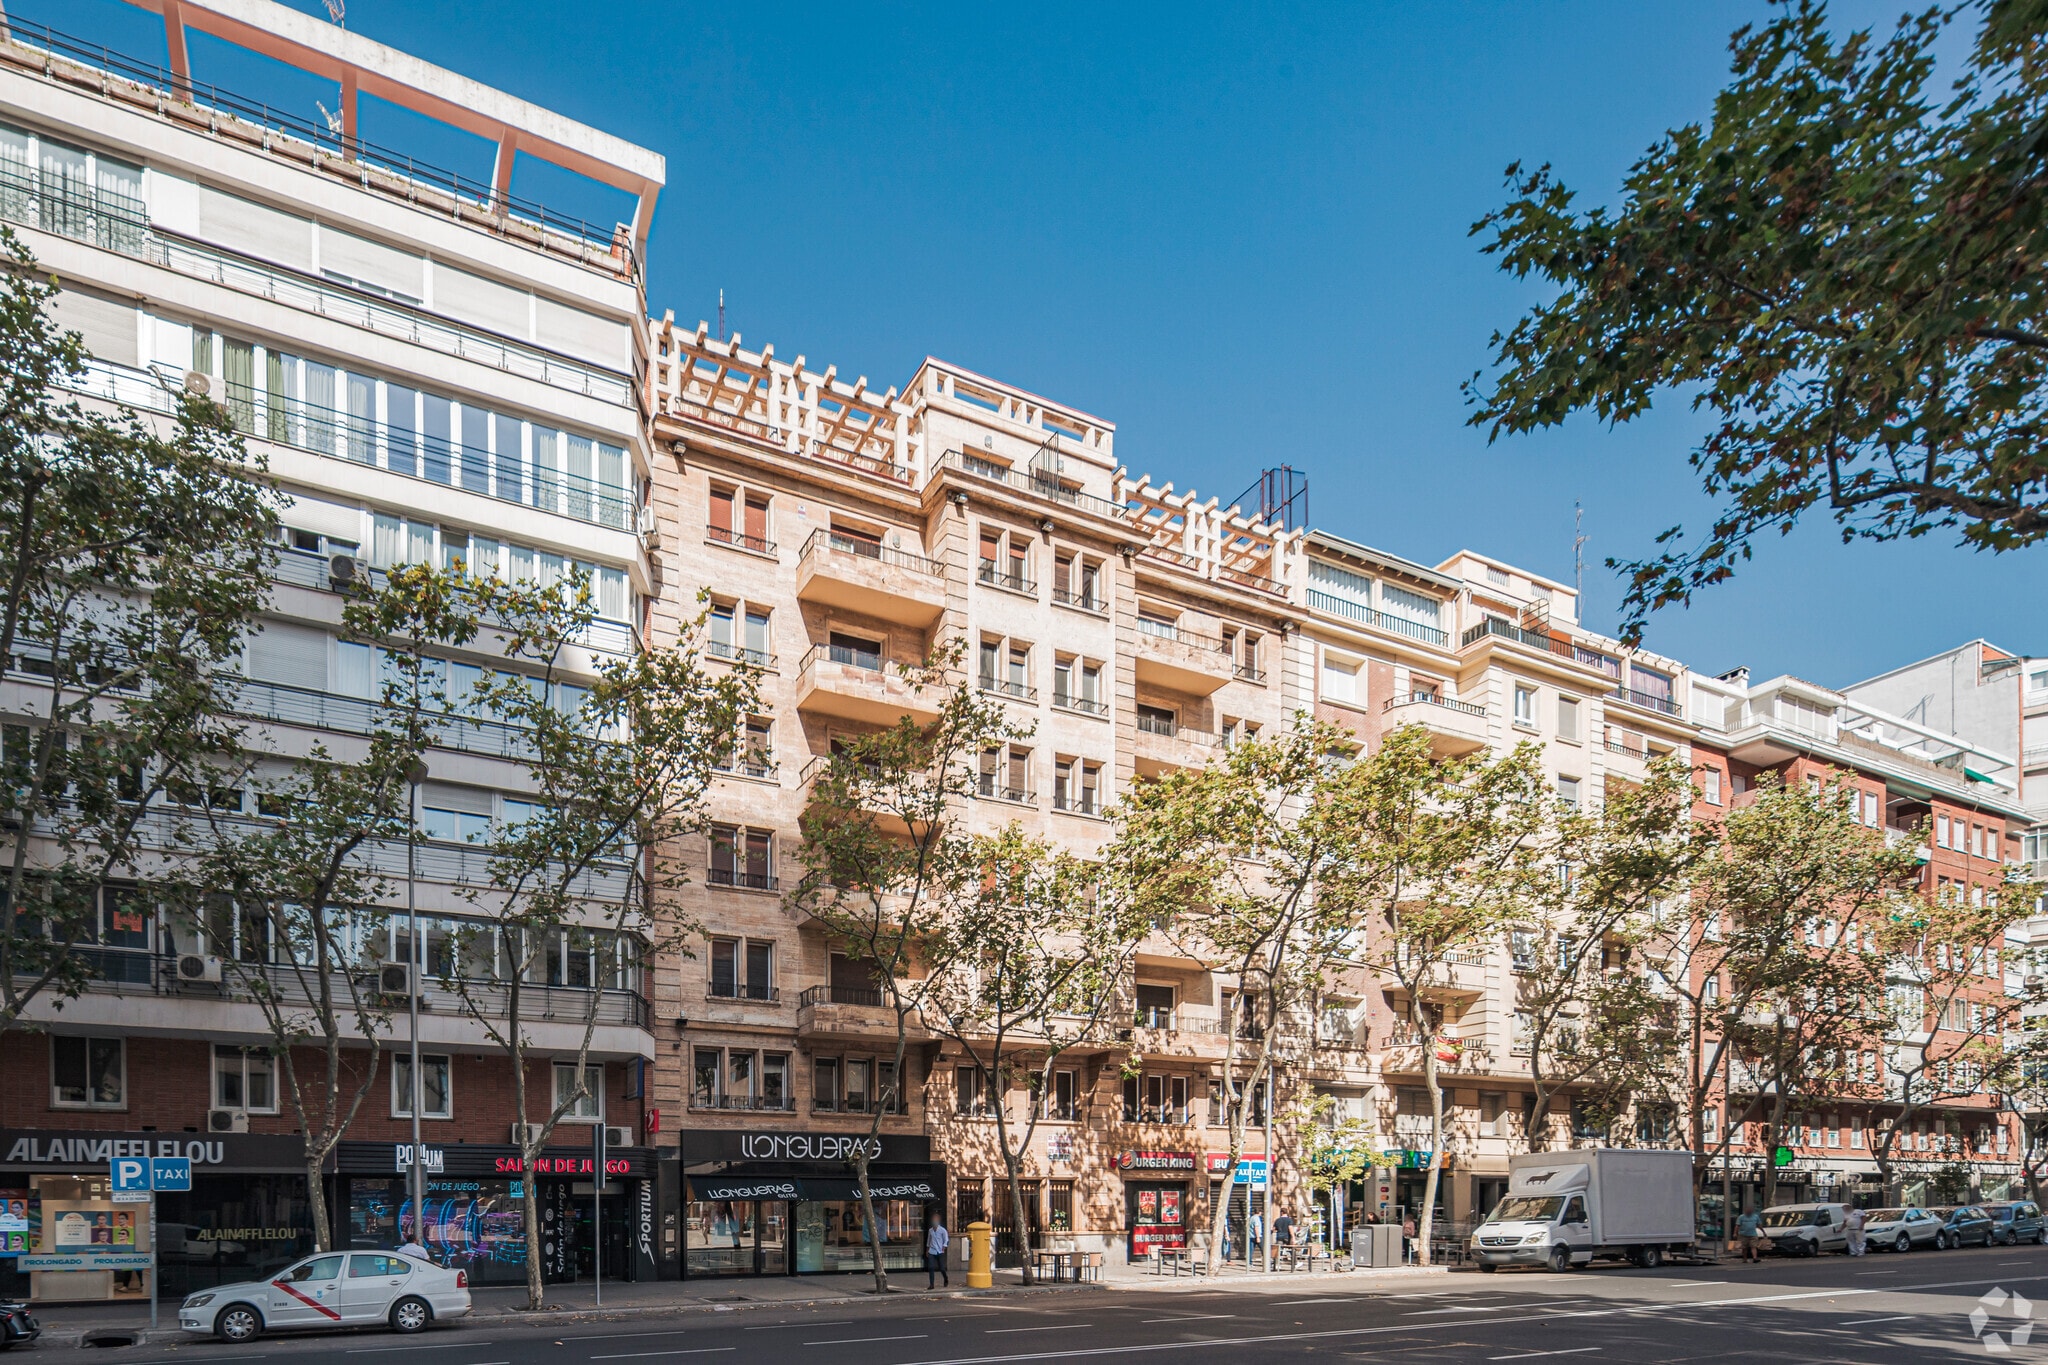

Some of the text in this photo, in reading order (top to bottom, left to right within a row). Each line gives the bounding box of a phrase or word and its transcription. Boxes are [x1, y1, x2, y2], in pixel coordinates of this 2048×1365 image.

[396, 1144, 443, 1166] POIUM
[555, 1158, 577, 1173] DE
[580, 1159, 631, 1174] JUGO
[1135, 1157, 1193, 1169] URGER KING
[119, 1160, 143, 1188] P
[155, 1169, 189, 1179] TAXI
[441, 1182, 453, 1191] DE
[453, 1182, 480, 1191] JUEGO
[707, 1183, 795, 1199] LLONGUERAS
[638, 1180, 655, 1265] SPORTIUM
[1134, 1233, 1184, 1242] BURGER KING
[24, 1258, 83, 1266] PROLONGADO
[94, 1257, 150, 1265] PROLONGADO
